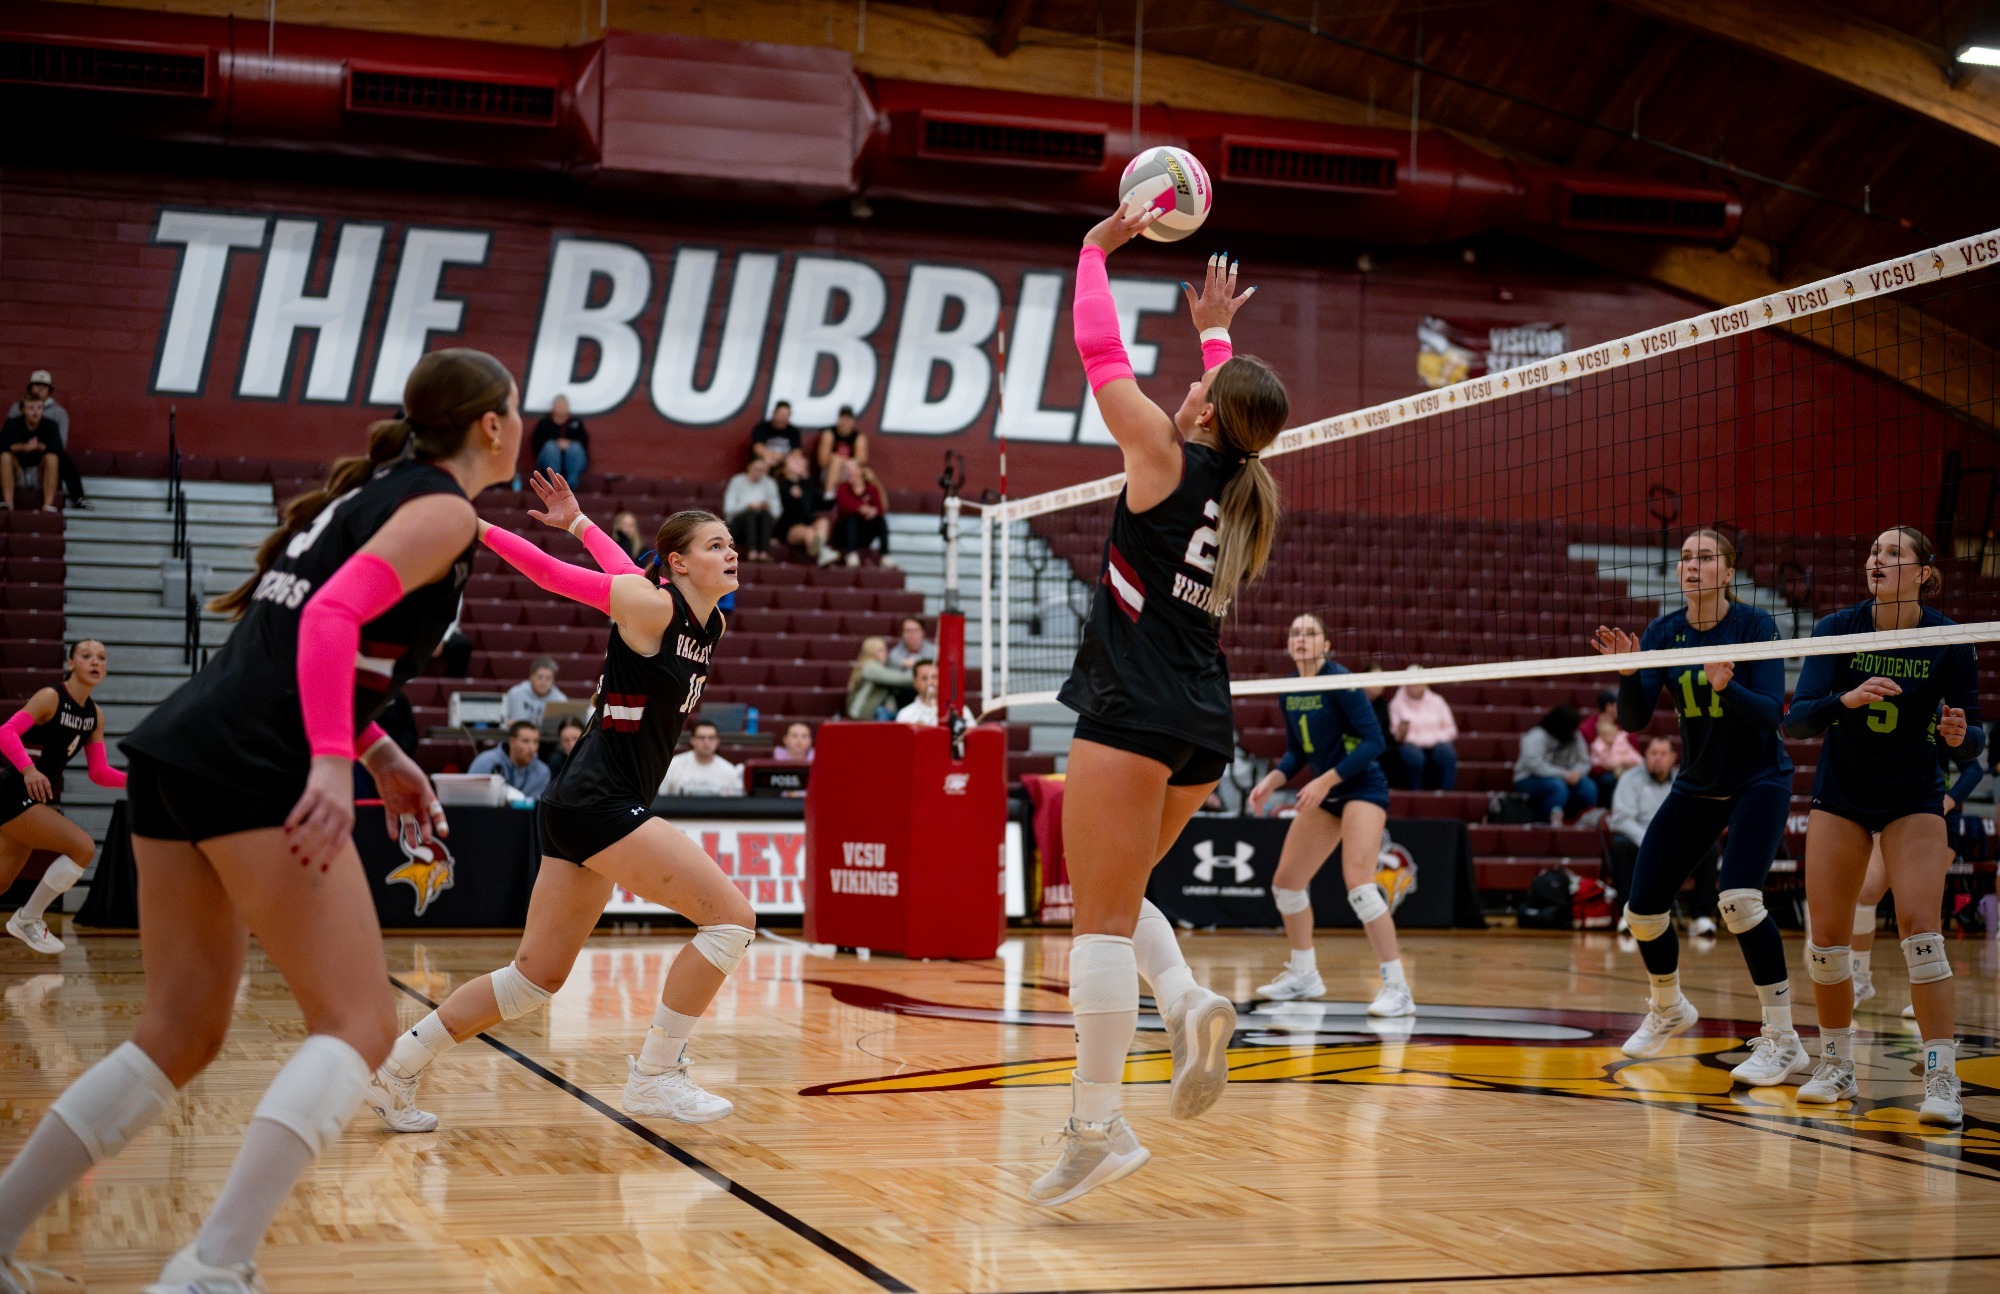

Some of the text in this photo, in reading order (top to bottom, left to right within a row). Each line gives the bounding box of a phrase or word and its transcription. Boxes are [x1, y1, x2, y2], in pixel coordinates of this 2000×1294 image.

[151, 207, 492, 407] THE
[1364, 409, 1391, 428] VCSU
[1412, 395, 1440, 415] VCSU
[1463, 381, 1492, 401] VCSU
[1518, 365, 1549, 387] VCSU
[1577, 348, 1611, 371] VCSU
[1641, 330, 1678, 354] VCSU
[1710, 310, 1750, 335] VCSU
[1786, 287, 1830, 315] VCSU
[1869, 262, 1916, 292] VCSU
[1959, 236, 2000, 266] VCS
[1183, 499, 1220, 575] 2
[676, 633, 713, 665] VALLEY
[1850, 652, 1931, 679] PROVIDENCE
[679, 673, 707, 714] 10
[1678, 669, 1724, 718] 17
[60, 711, 83, 731] VALLEY
[1298, 713, 1315, 753] 1
[1866, 700, 1899, 734] 5
[842, 841, 886, 868] VCSU
[830, 868, 899, 897] VIKINGS
